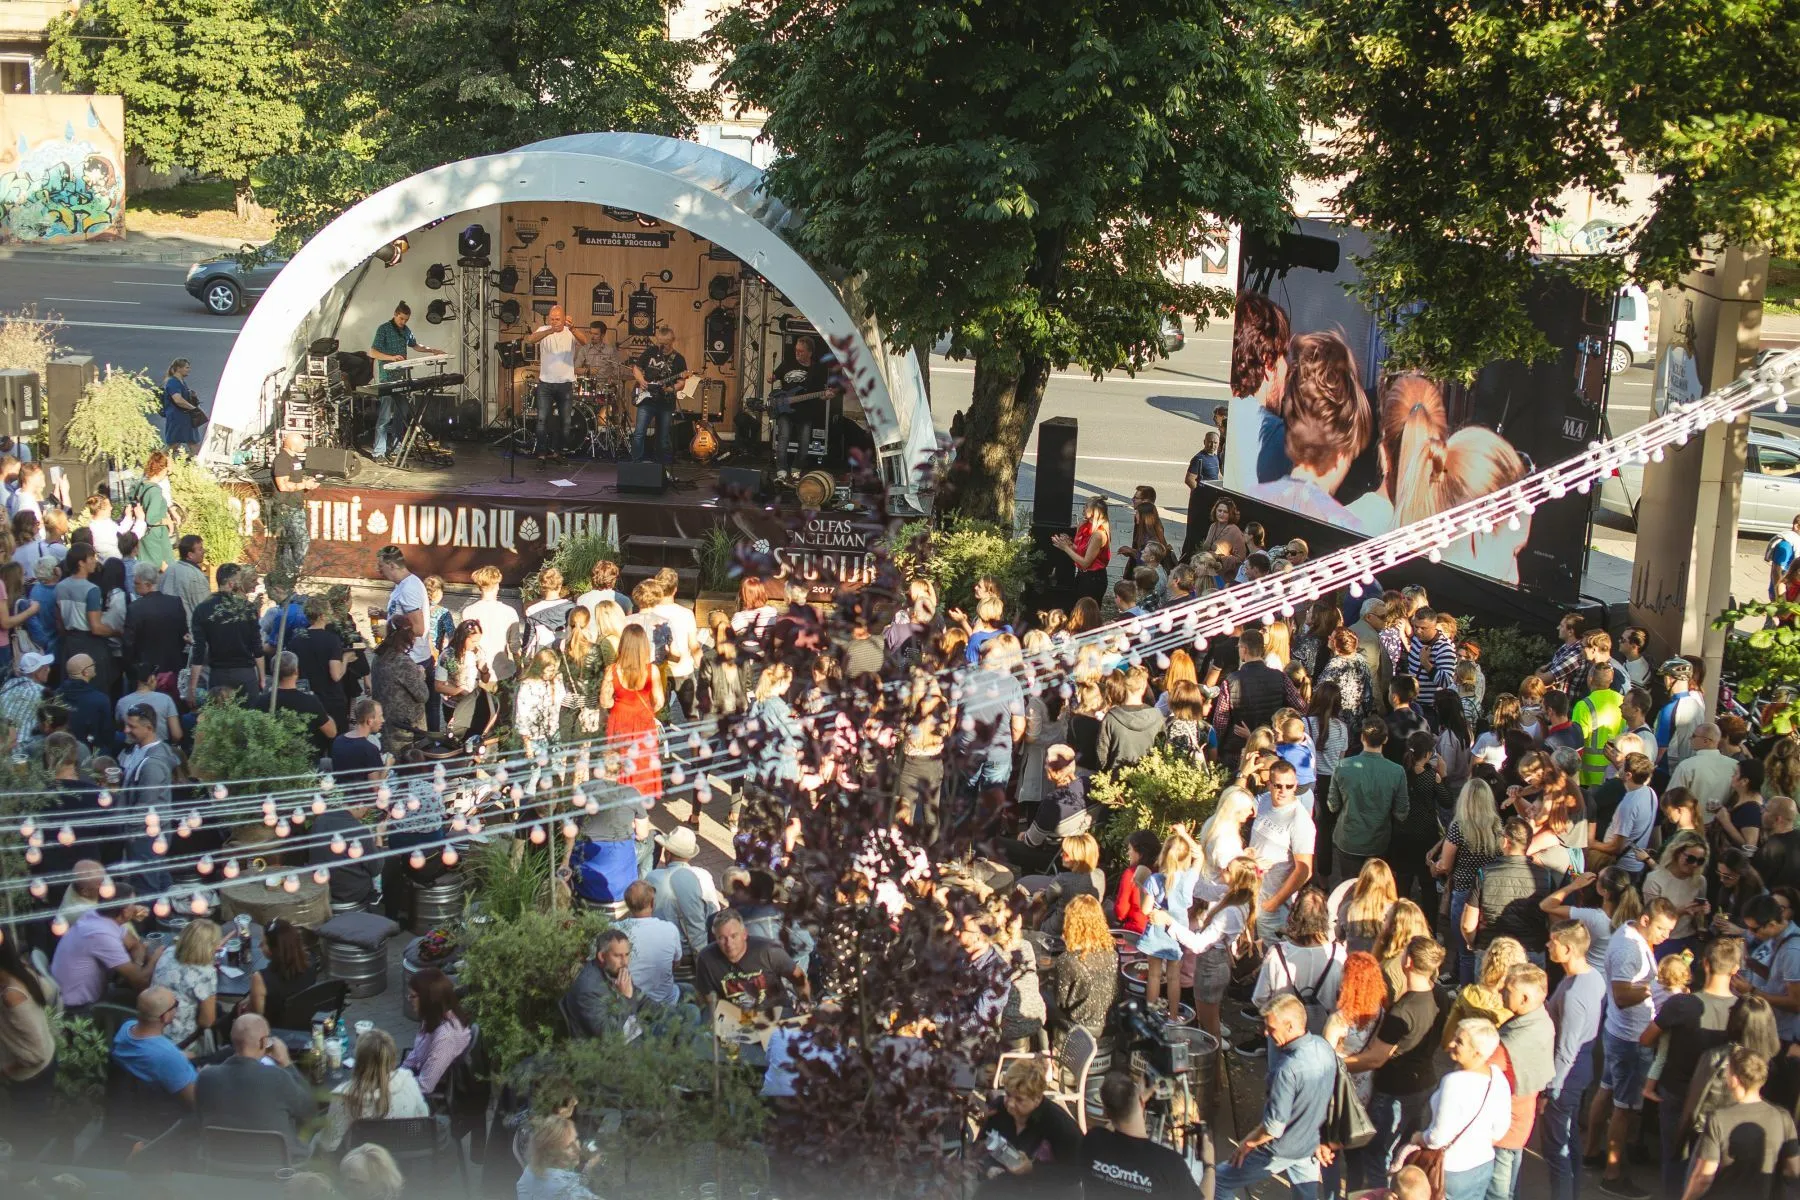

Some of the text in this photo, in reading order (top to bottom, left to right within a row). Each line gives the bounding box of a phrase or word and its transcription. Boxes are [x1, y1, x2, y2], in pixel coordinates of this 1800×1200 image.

[611, 232, 637, 240] ALAUS
[586, 237, 662, 247] GAMYBOS PROCESAS
[390, 504, 519, 554] ALUDARIŲ
[545, 511, 621, 553] DIENA
[804, 519, 852, 534] OLFAS
[812, 585, 835, 594] 2017
